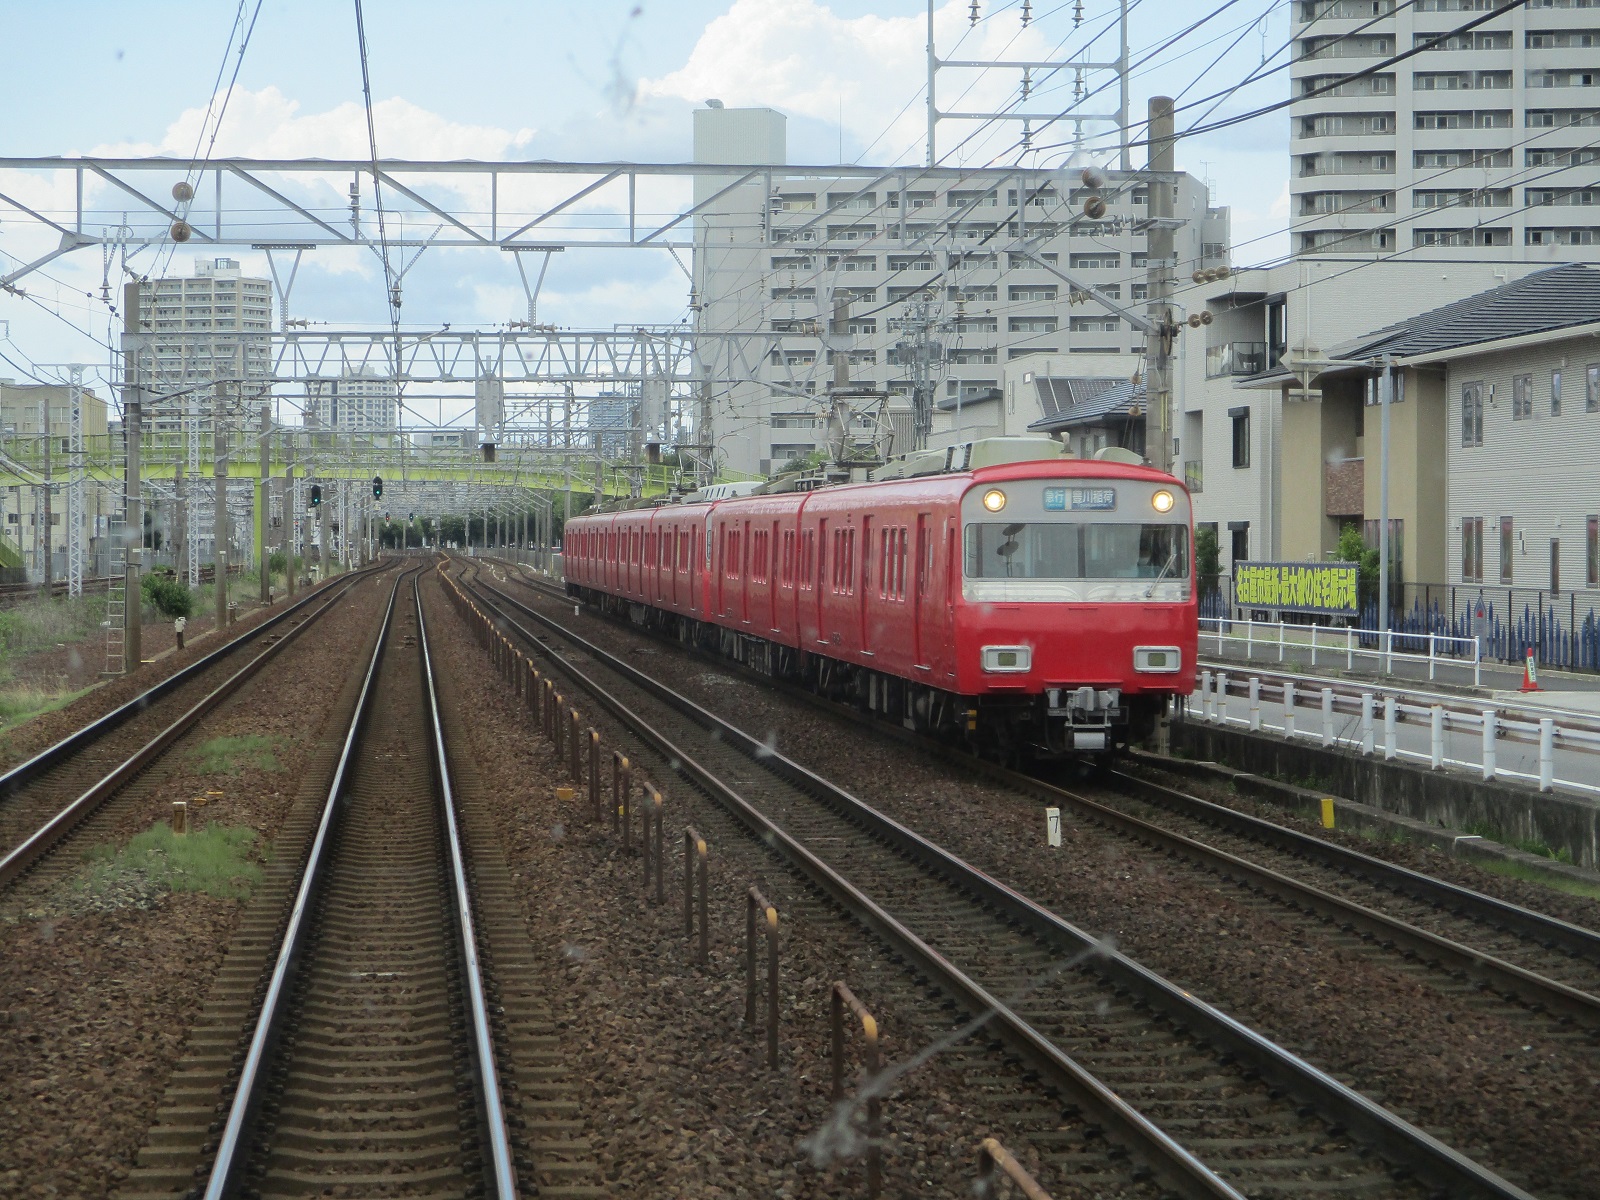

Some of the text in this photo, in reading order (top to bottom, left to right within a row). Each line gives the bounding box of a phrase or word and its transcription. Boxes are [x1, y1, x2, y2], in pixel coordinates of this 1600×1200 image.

[1045, 489, 1113, 504] 急行 豊川稲荷
[1236, 565, 1357, 610] 名古屋市最新・最大級の住宅展示場
[1049, 816, 1059, 834] 7
